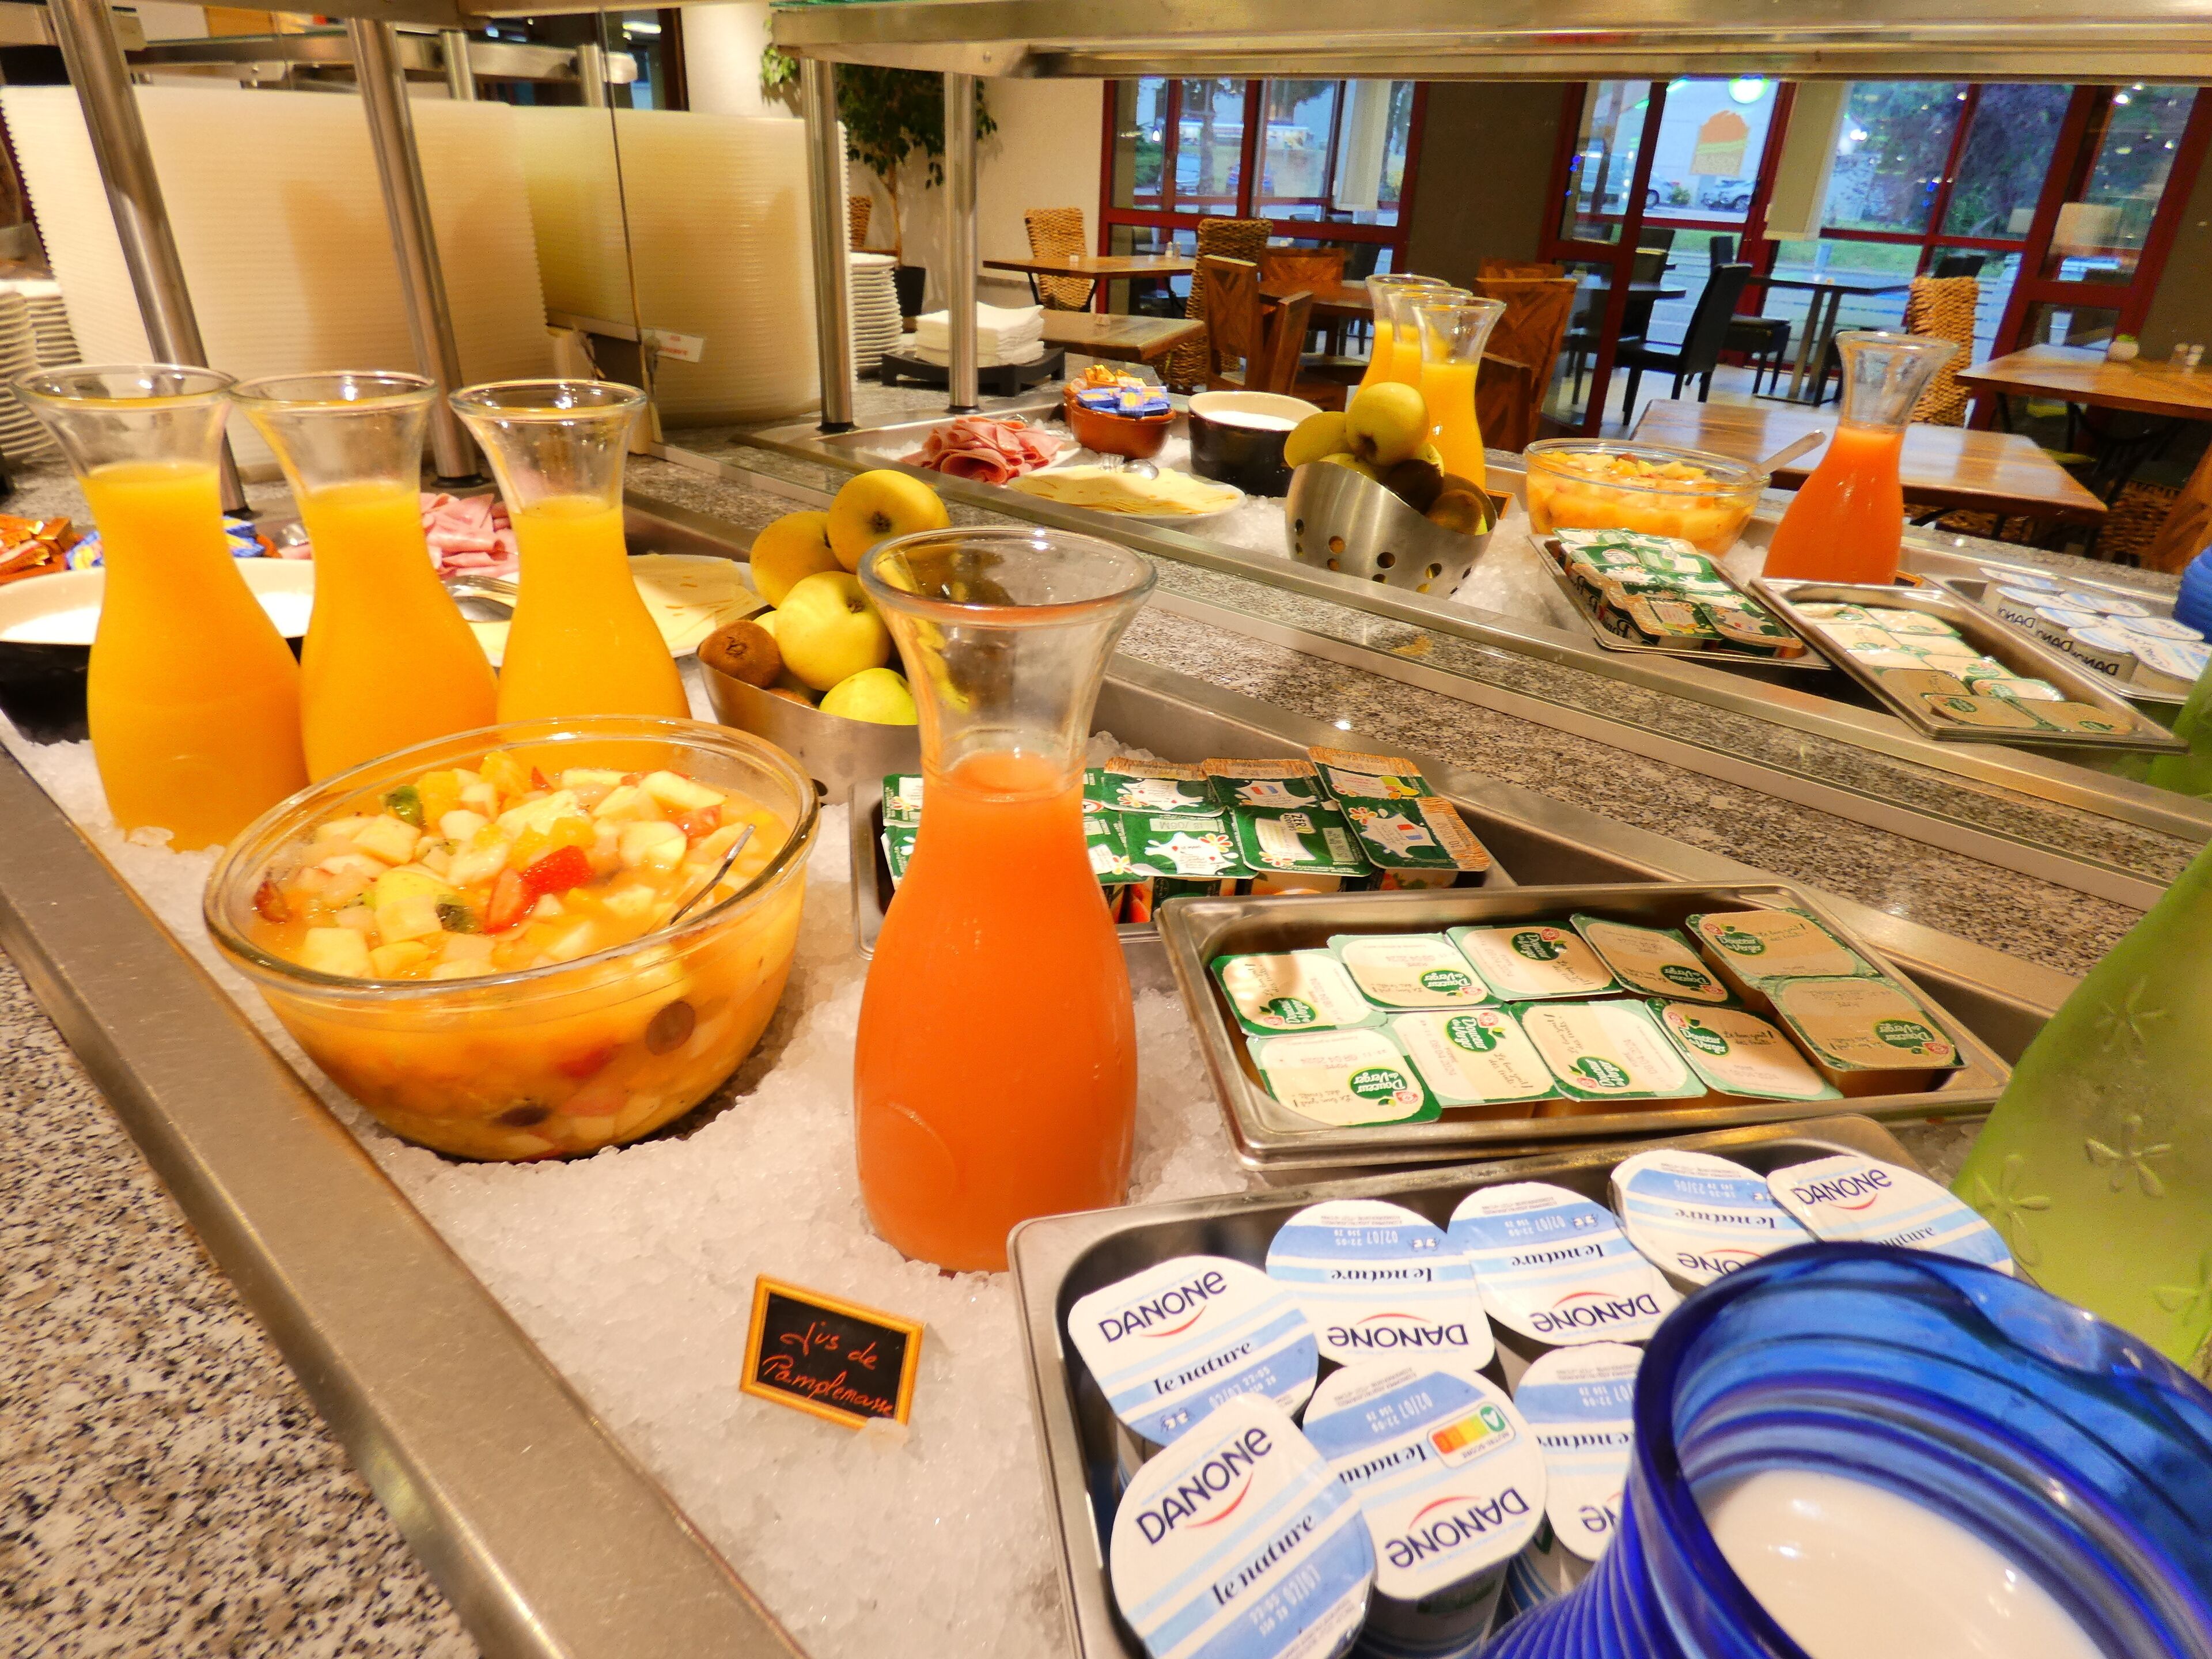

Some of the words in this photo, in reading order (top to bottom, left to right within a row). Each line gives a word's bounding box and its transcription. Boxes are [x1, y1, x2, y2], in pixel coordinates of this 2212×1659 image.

[1518, 941, 1539, 959] Verger
[1527, 934, 1550, 959] Douceur
[1427, 979, 1470, 987] Douceur
[1453, 1027, 1474, 1048] Verger
[1463, 1018, 1488, 1050] Douceur
[1354, 1072, 1388, 1084] Verger
[1586, 1060, 1614, 1086] Douceur
[1600, 1060, 1622, 1081] Verger
[1357, 1080, 1404, 1093] Douceur
[1790, 1169, 1893, 1206] DANONE
[1535, 1215, 1566, 1232] 02/07
[1675, 1208, 1751, 1225] nature
[1756, 1216, 1777, 1229] le
[1366, 1230, 1399, 1244] 02/07
[1511, 1247, 1582, 1267] nature
[1585, 1243, 1604, 1259] le
[1331, 1269, 1409, 1283] nature
[1414, 1268, 1433, 1283] le
[1097, 1271, 1228, 1343] DANONE
[1529, 1293, 1661, 1332] DANONE
[1327, 1324, 1469, 1348] DANONE
[847, 1341, 878, 1370] de
[1153, 1377, 1175, 1395] le
[1178, 1341, 1252, 1385] nature
[1398, 1392, 1434, 1419] 02/07
[1406, 1443, 1429, 1461] le
[1338, 1454, 1400, 1484] natur
[1135, 1427, 1273, 1546] DANONE
[1385, 1486, 1530, 1569] DANONE
[1210, 1580, 1240, 1606] le
[1239, 1514, 1316, 1587] nature
[1283, 1565, 1322, 1607] 02/07
